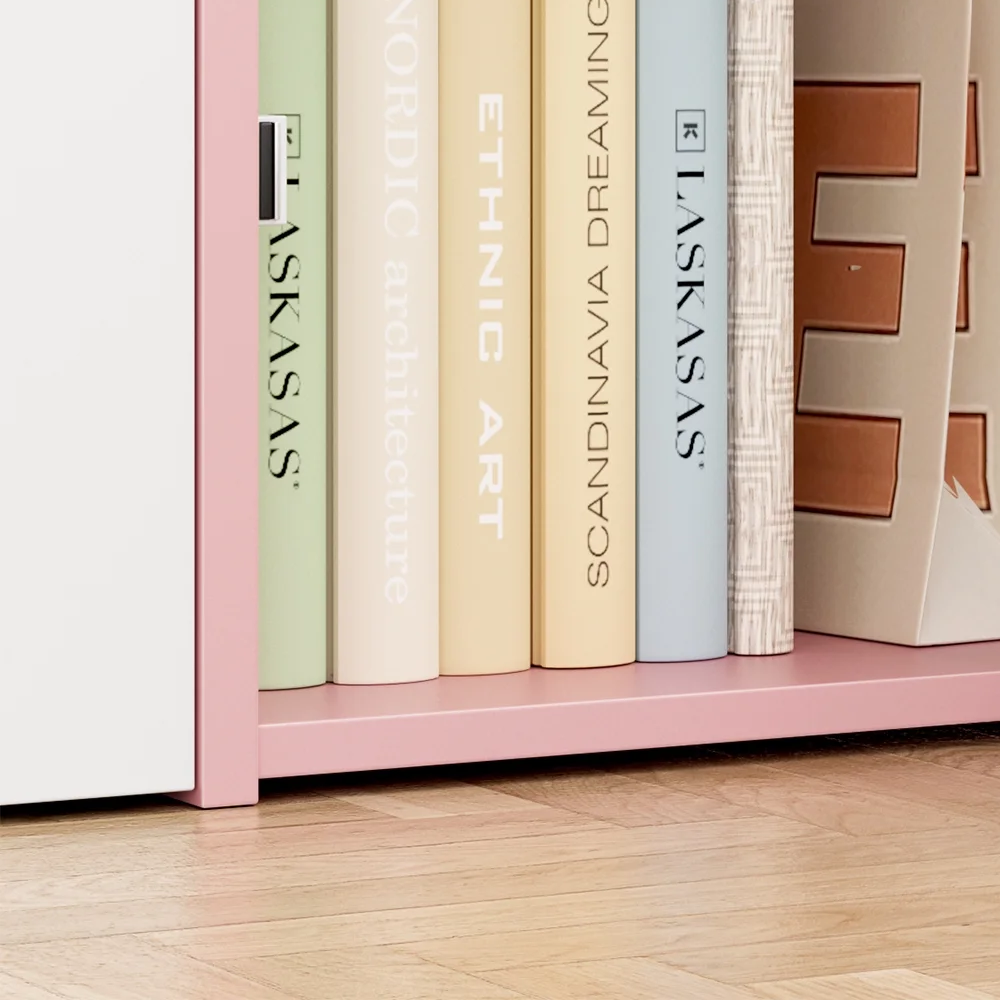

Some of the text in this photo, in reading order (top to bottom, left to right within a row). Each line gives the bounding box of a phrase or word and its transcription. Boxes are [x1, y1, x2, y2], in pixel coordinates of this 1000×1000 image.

[384, 259, 420, 605] architecture
[478, 93, 504, 540] ETHNIC ART
[586, 264, 610, 588] SCANDINAVIA
[674, 165, 706, 468] LASKASAS
